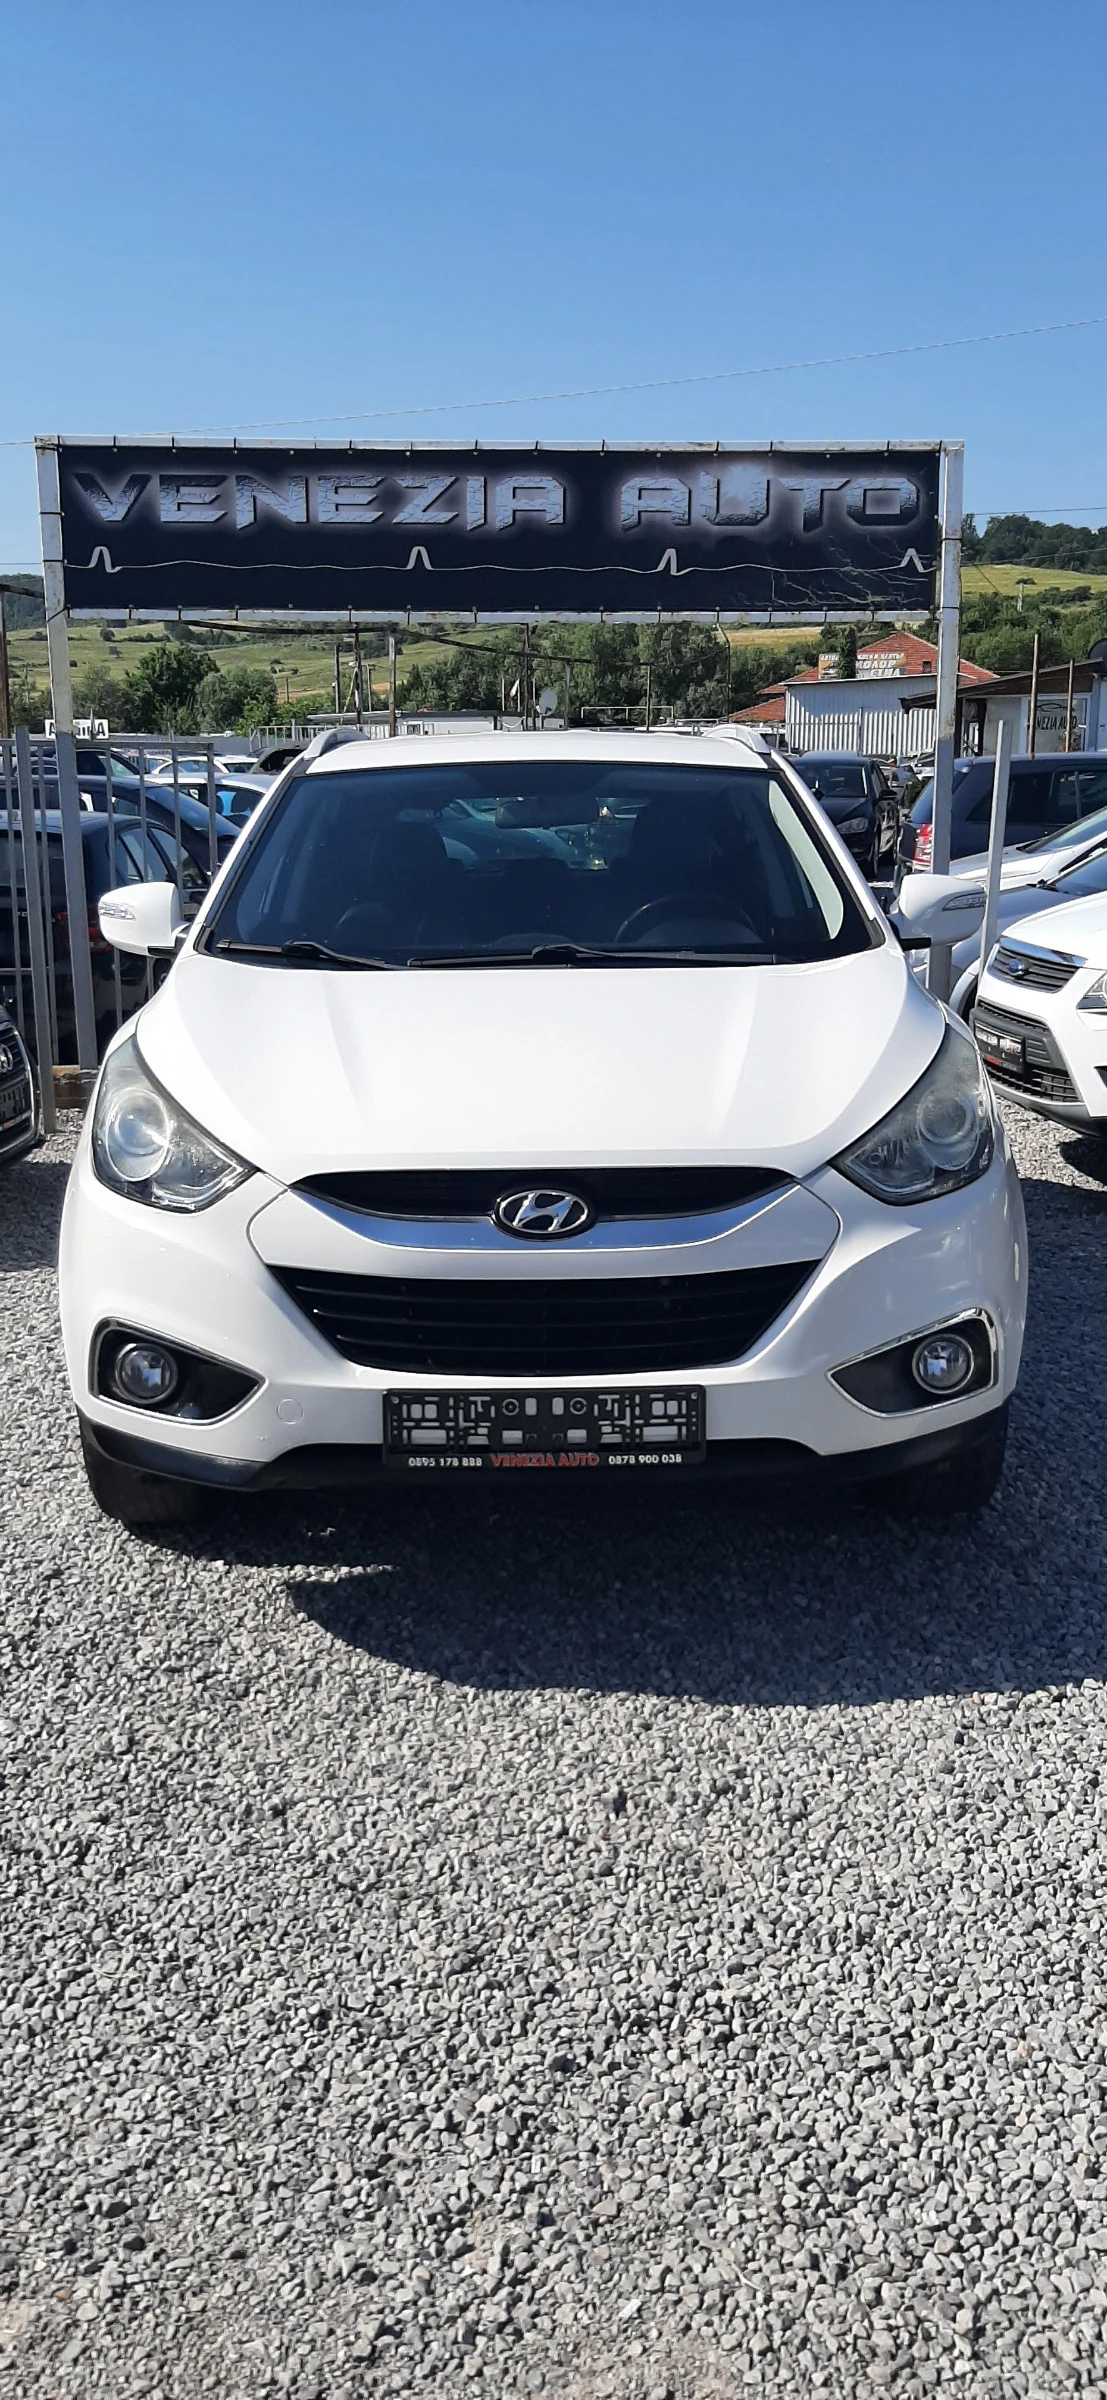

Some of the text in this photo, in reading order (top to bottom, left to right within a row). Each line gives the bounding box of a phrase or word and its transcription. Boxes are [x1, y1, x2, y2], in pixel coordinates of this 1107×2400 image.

[74, 471, 921, 533] VENEZIA AUTO
[408, 1452, 682, 1467] 0895 178 888 VENEZIA AUTO 0878 900 038
